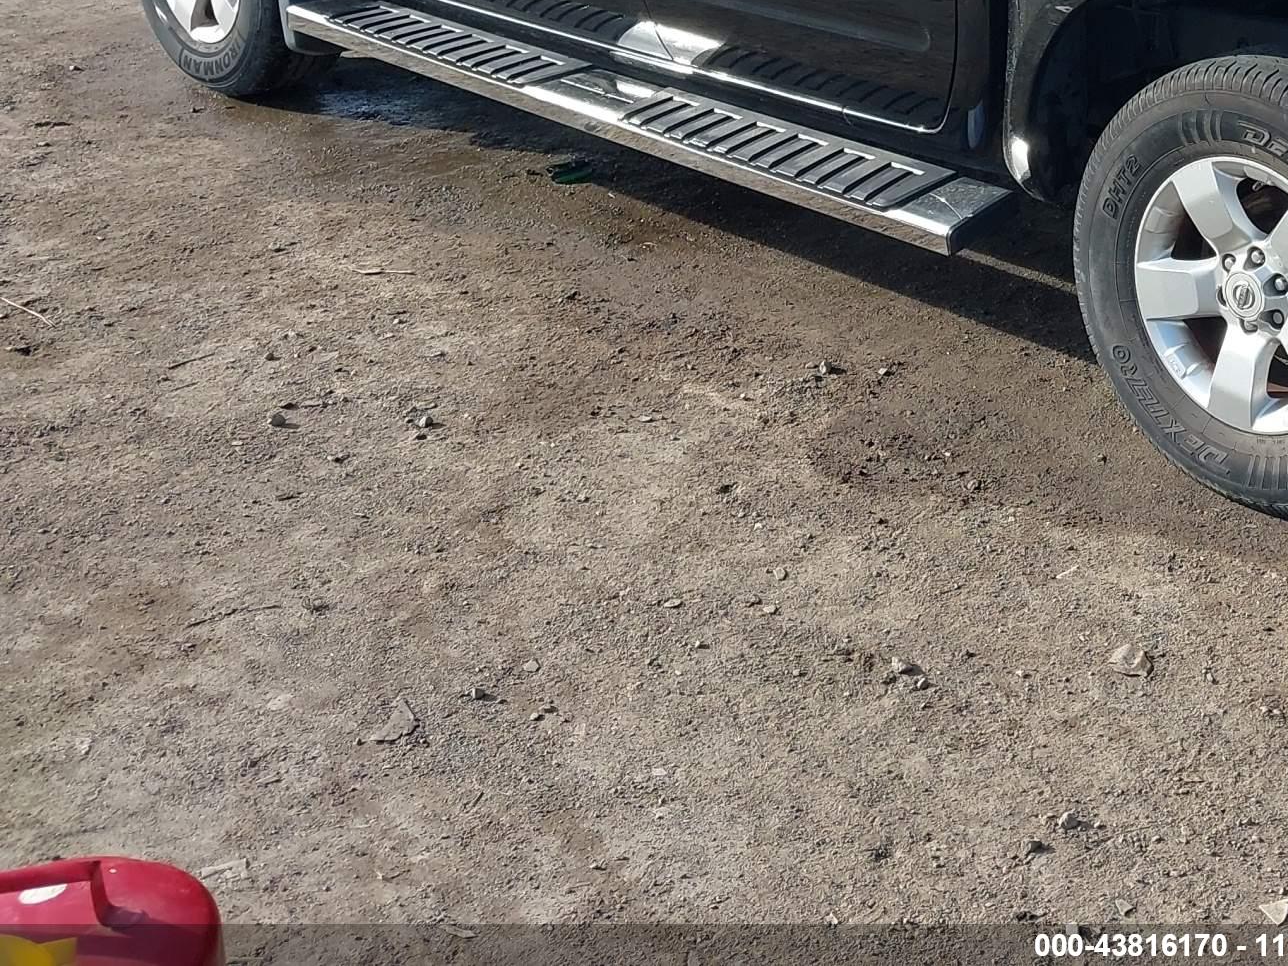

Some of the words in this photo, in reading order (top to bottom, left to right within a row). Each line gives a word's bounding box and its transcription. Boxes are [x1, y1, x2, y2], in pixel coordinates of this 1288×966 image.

[183, 37, 242, 76] IRONMAN
[1101, 153, 1142, 221] DHT2
[1112, 344, 1231, 475] DEXTERO
